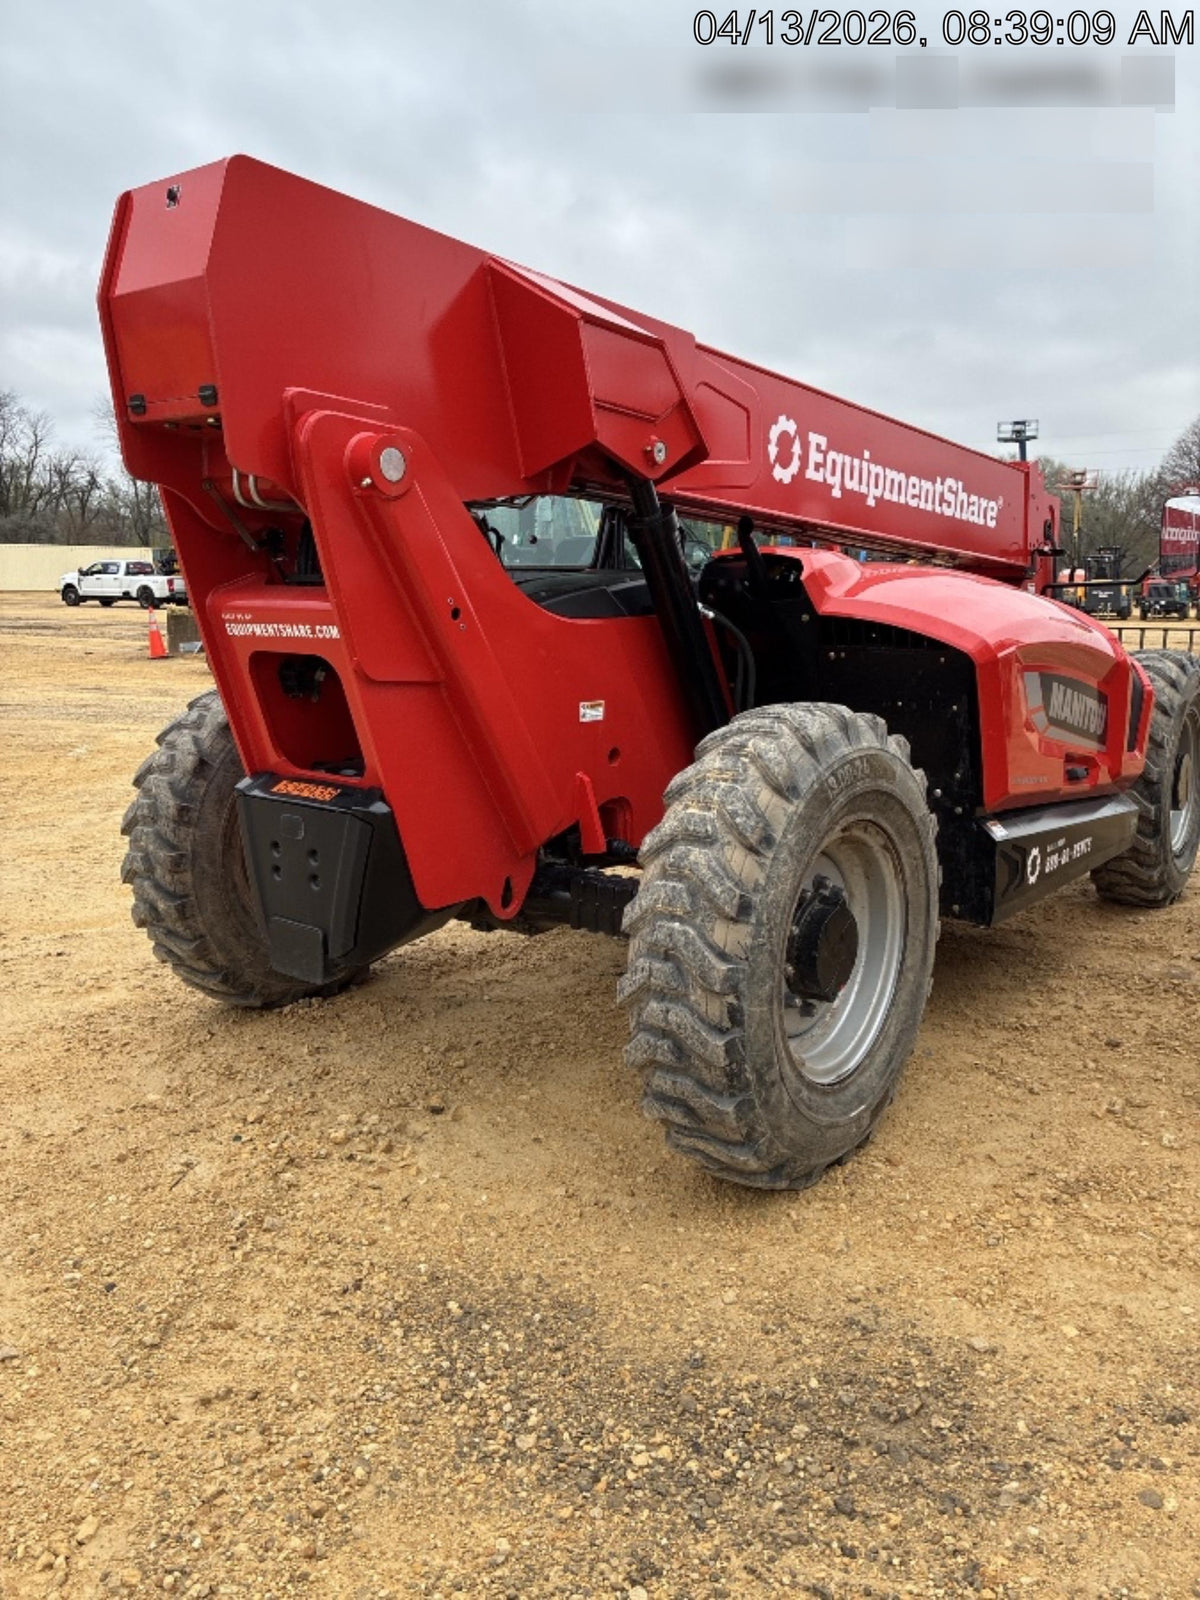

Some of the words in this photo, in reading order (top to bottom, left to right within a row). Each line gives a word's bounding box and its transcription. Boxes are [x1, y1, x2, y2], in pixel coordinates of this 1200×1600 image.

[805, 431, 999, 529] EquipmentShare
[225, 623, 340, 639] EQUIPMENTSHARE.COM
[1049, 682, 1107, 735] MANITOU
